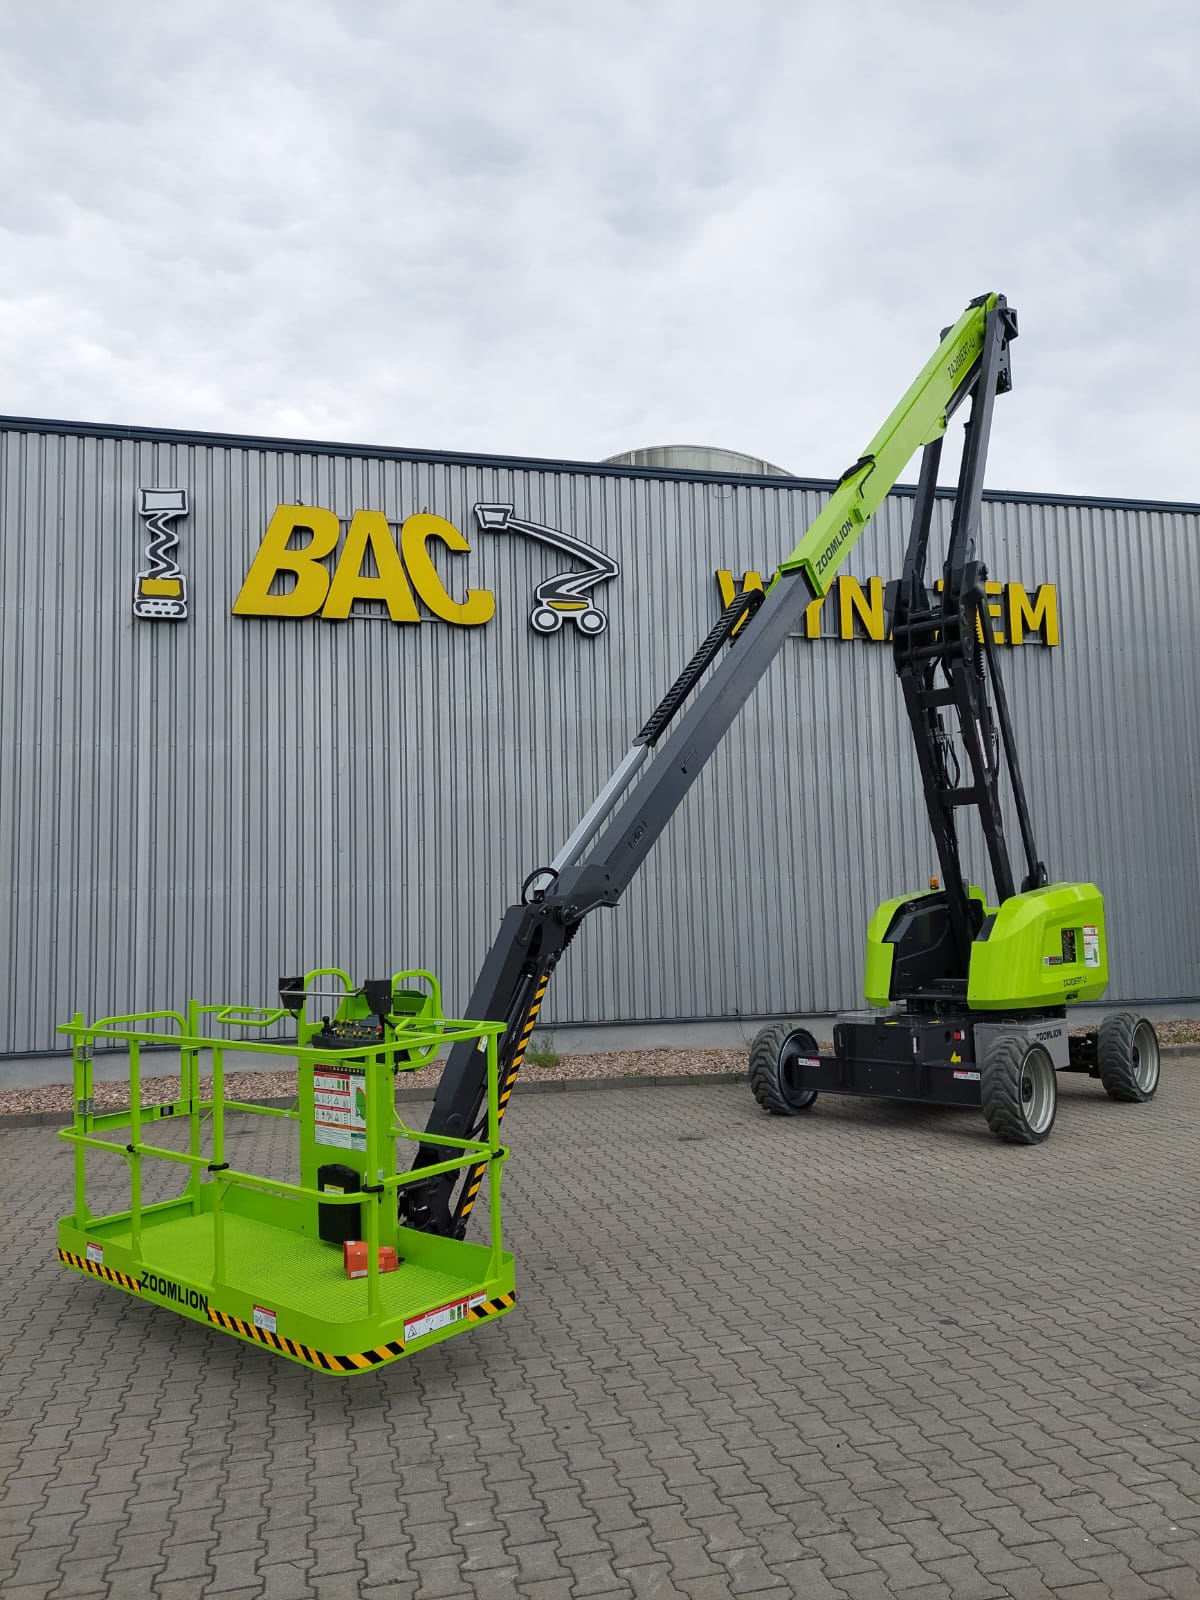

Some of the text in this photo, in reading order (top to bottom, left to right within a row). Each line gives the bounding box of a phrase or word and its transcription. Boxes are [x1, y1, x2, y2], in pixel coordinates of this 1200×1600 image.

[232, 504, 496, 626] BAC
[815, 517, 854, 575] ZOOMLION
[140, 1270, 209, 1314] ZOOMLION
